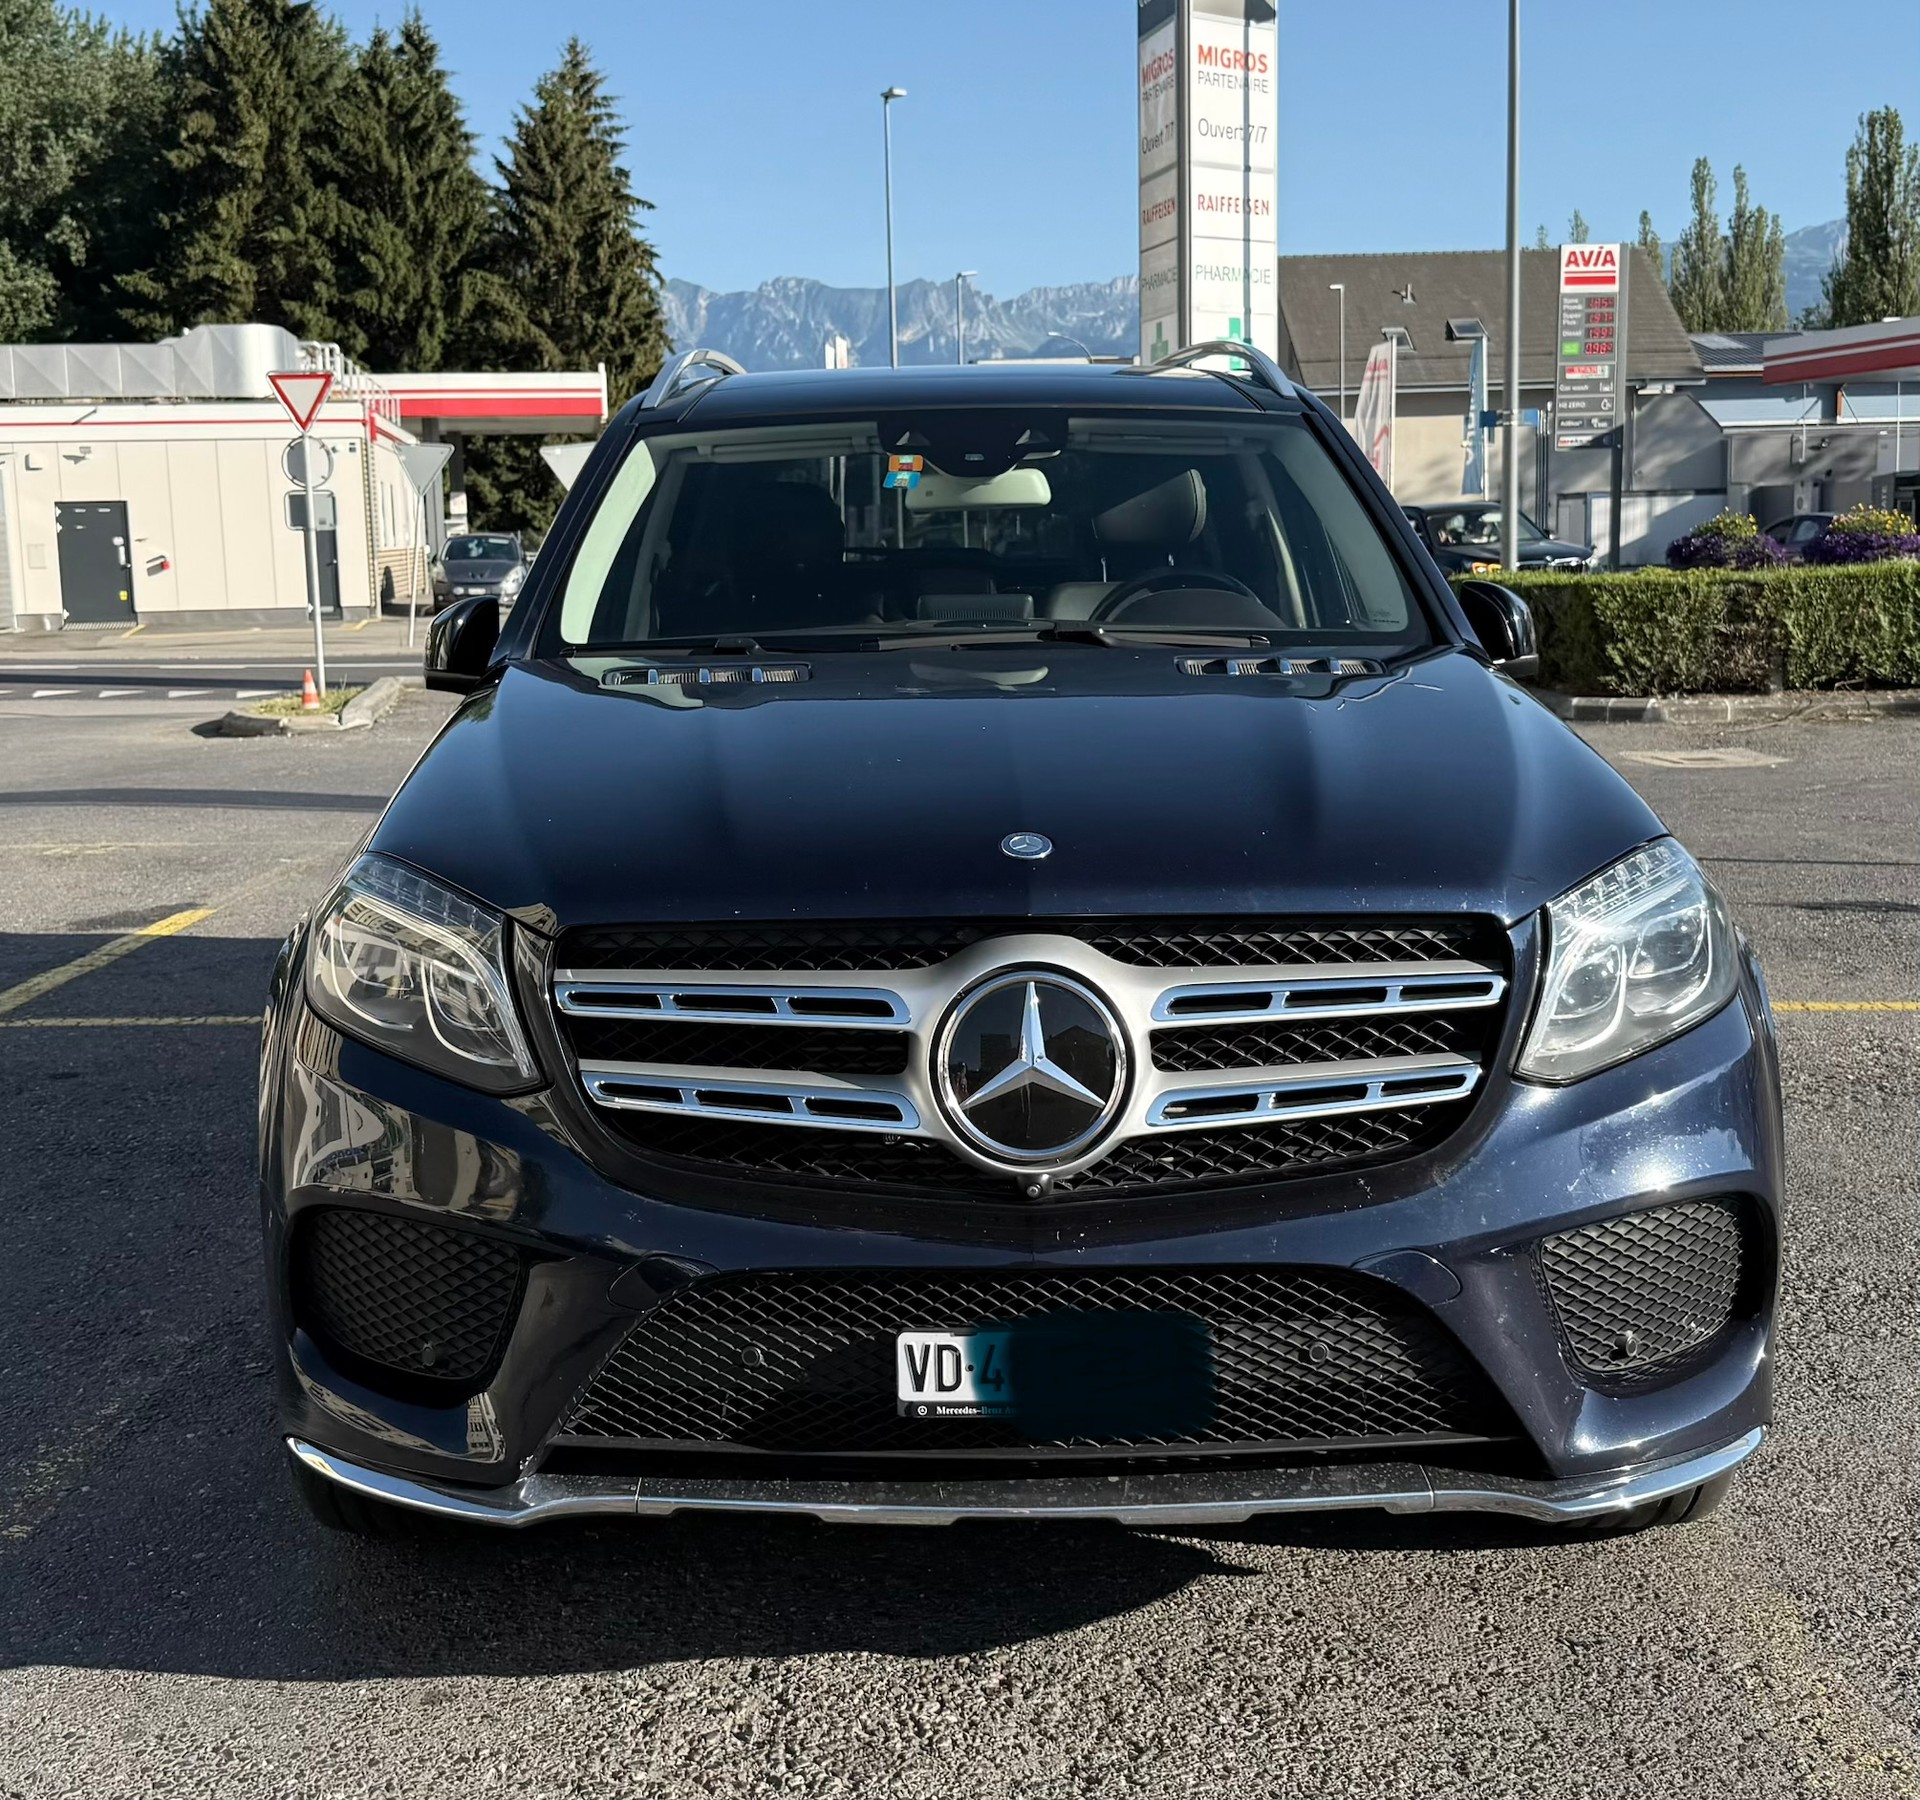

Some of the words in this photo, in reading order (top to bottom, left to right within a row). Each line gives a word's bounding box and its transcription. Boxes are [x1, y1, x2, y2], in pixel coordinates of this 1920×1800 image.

[1142, 49, 1174, 86] MIGROS
[1197, 44, 1268, 73] MIGROS
[1197, 194, 1270, 216] RAIFFEISEN
[1195, 265, 1271, 284] PHARMACIE
